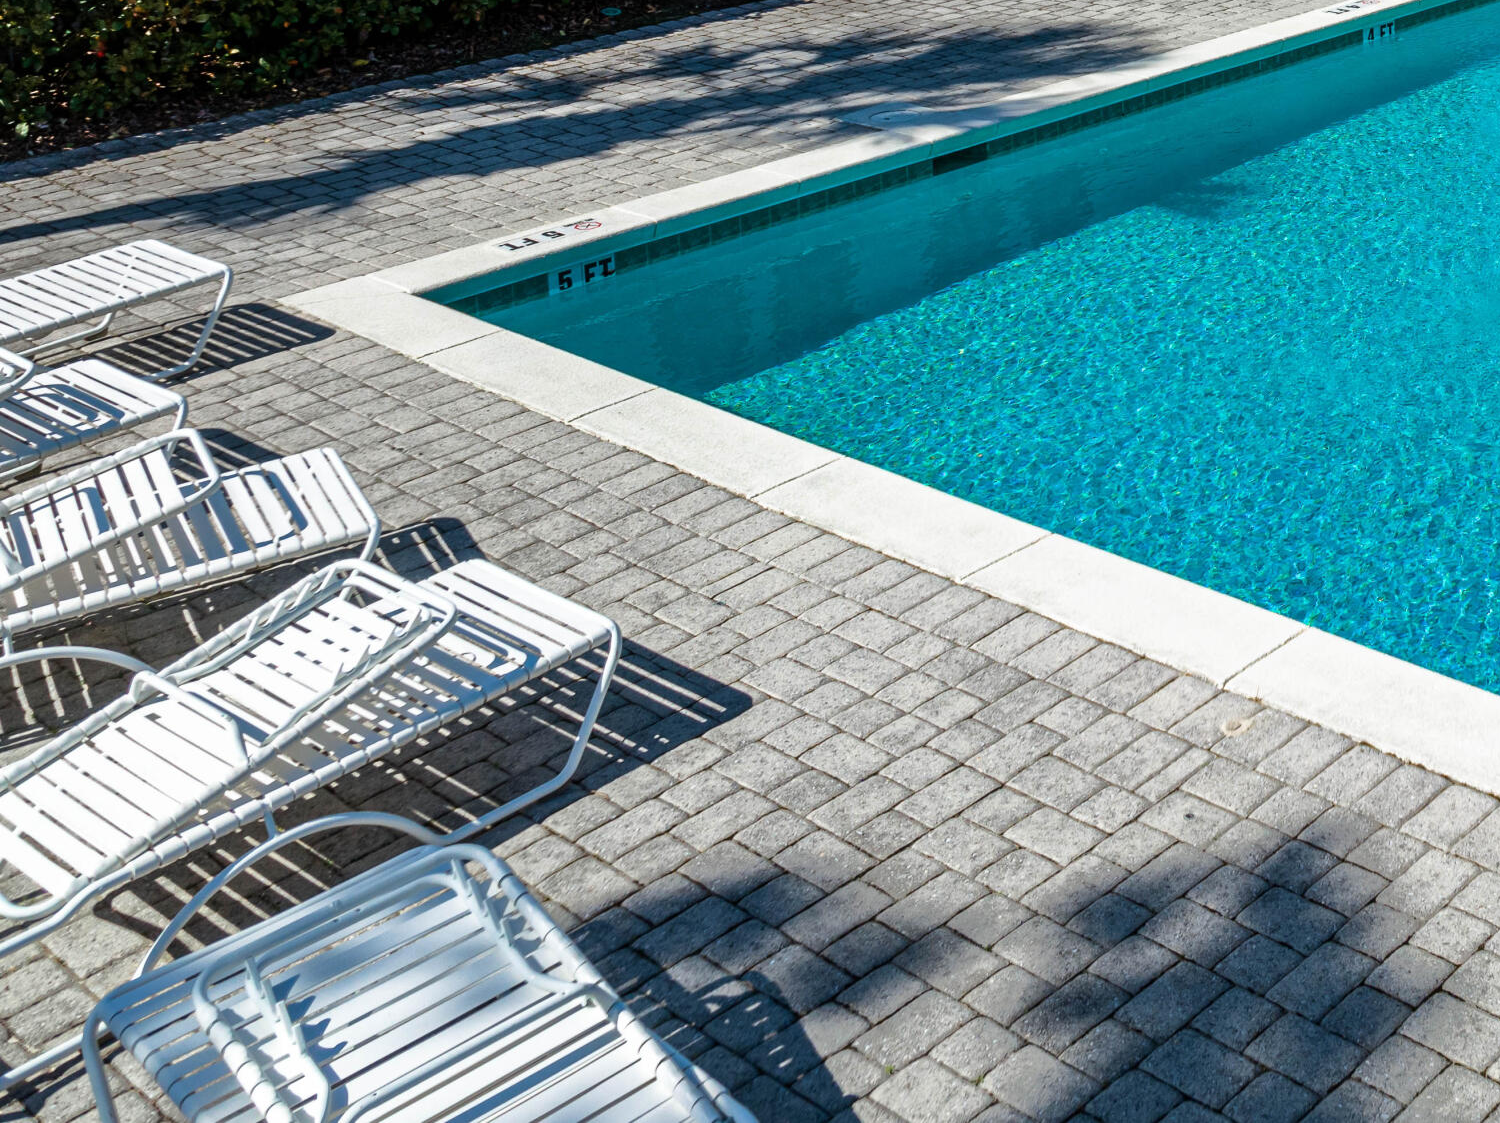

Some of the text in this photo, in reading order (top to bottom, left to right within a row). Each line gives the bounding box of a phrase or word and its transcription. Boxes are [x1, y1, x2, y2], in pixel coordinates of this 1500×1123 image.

[1367, 27, 1374, 40] 4
[541, 230, 566, 239] 5
[558, 269, 573, 290] 5
